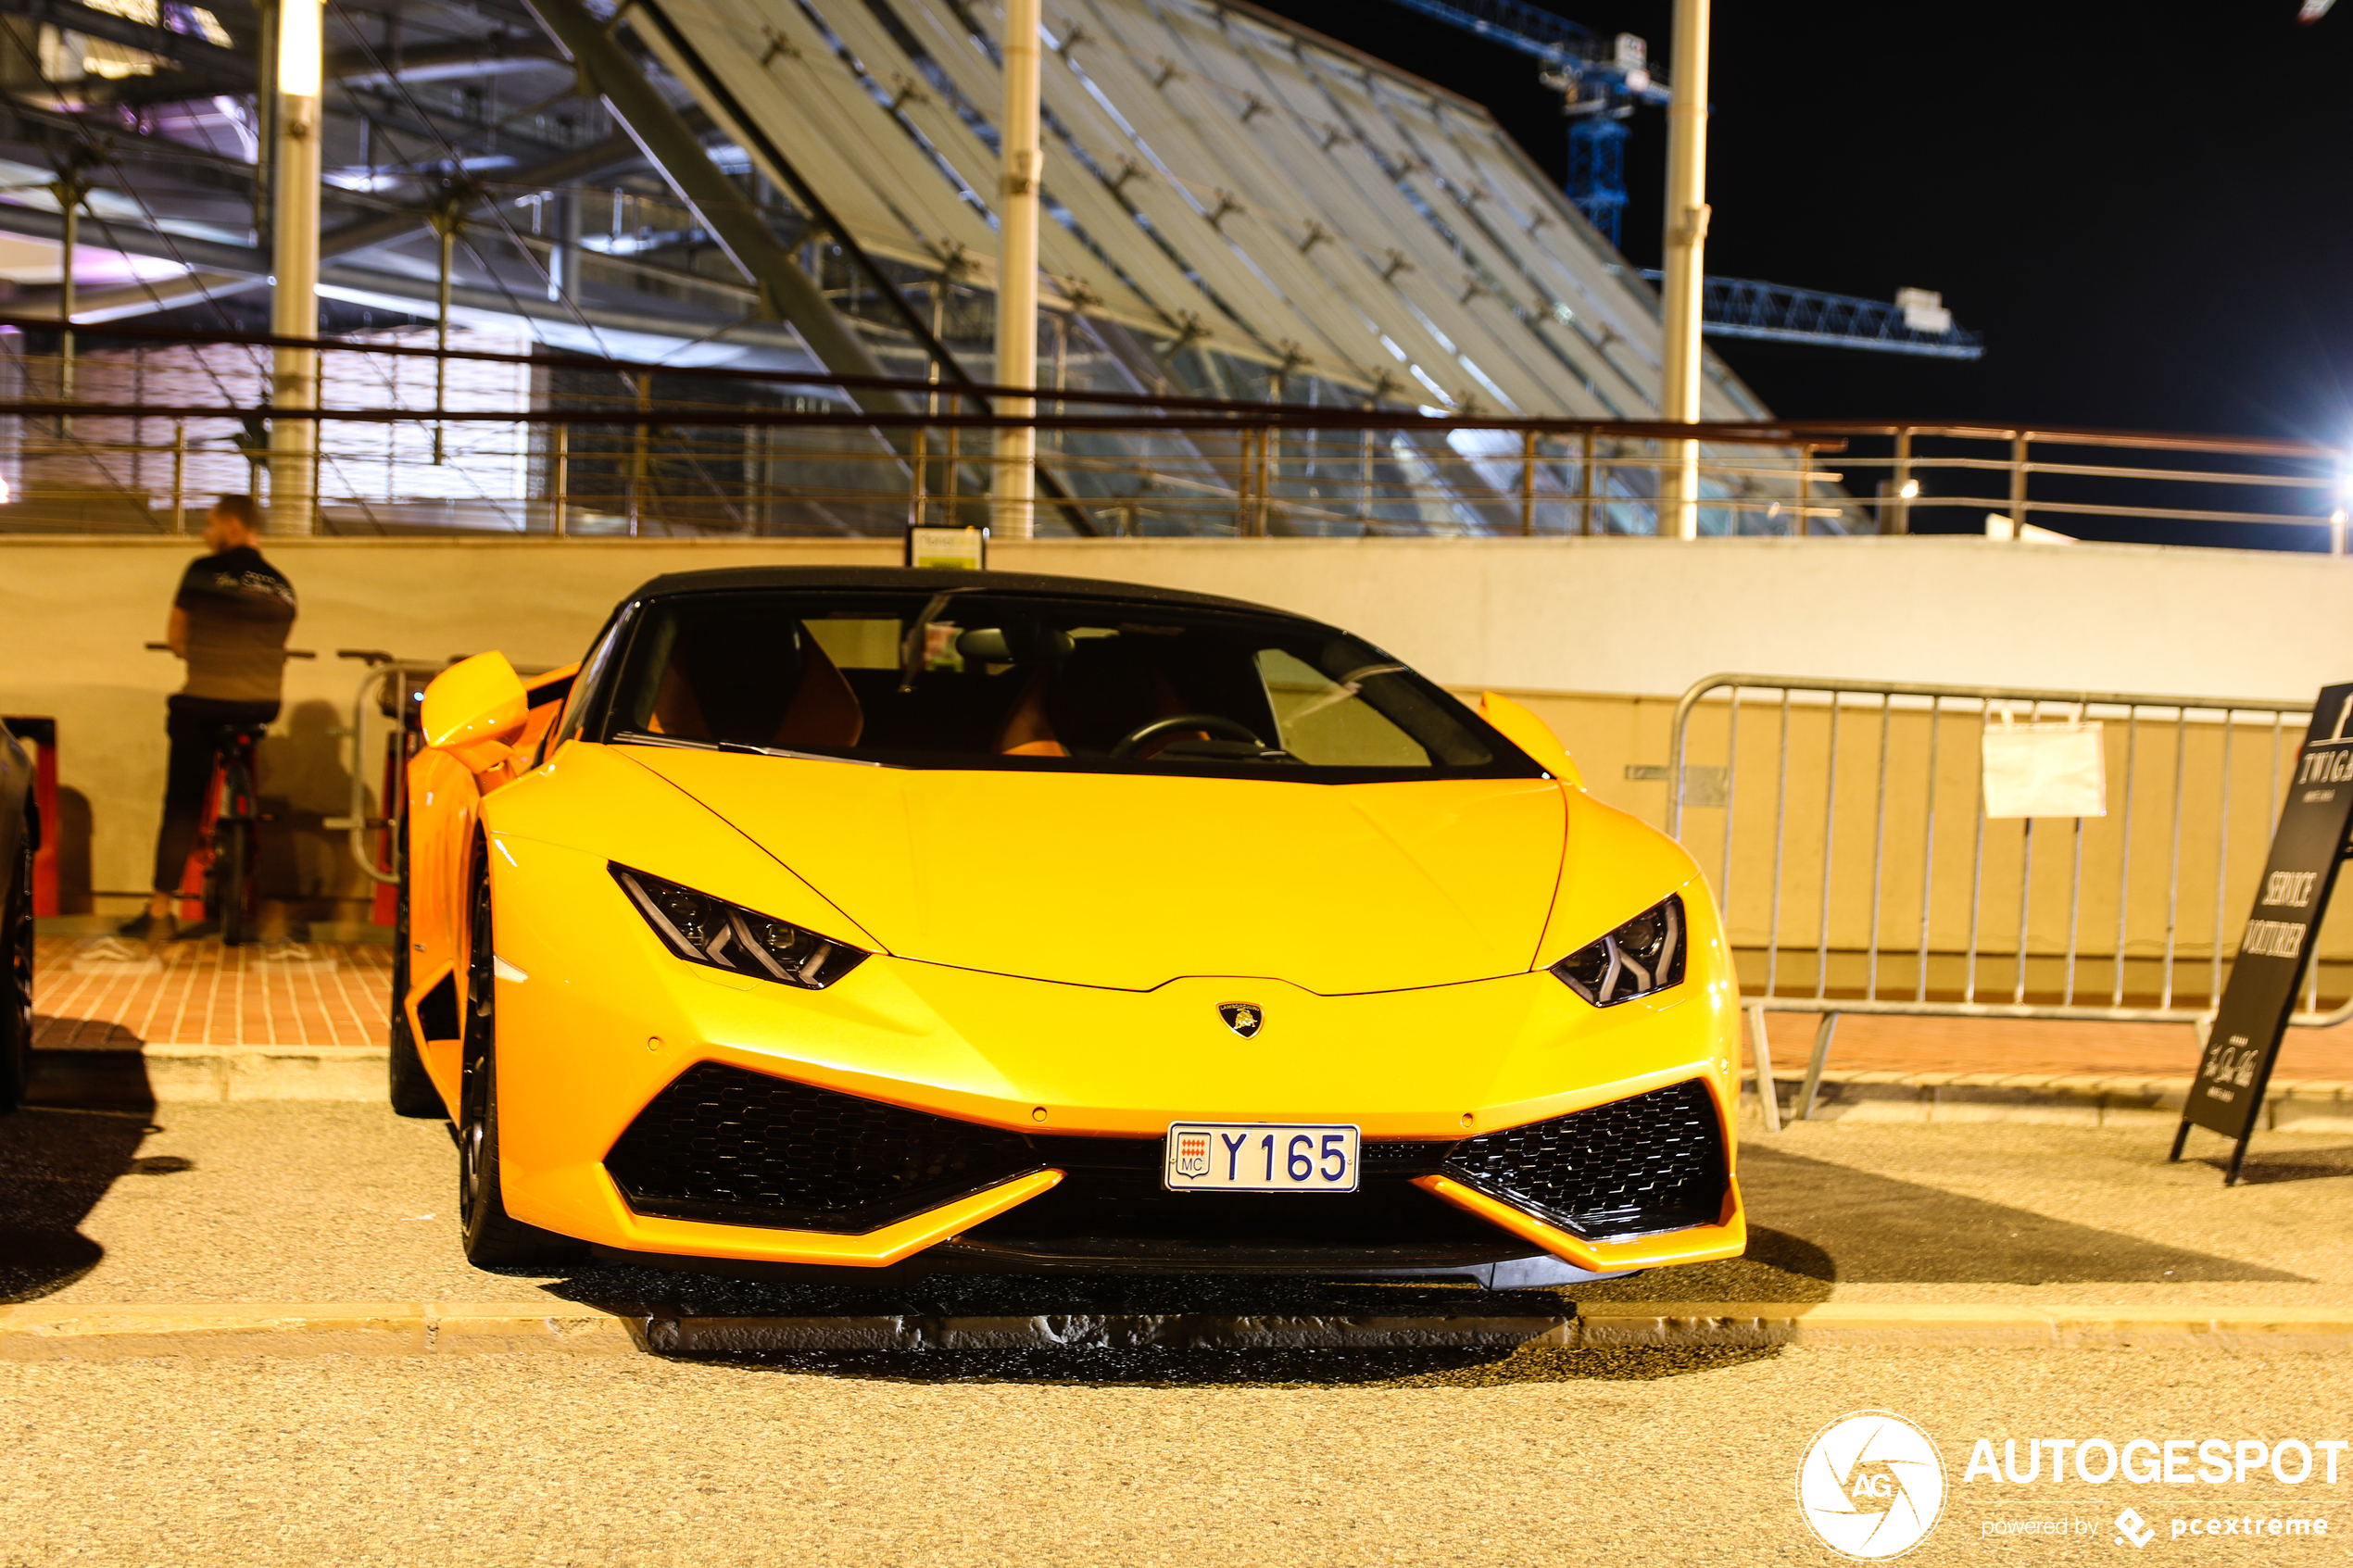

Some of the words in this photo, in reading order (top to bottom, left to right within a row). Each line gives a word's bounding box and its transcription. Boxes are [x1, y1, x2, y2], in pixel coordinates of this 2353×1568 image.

[2262, 871, 2317, 907] SERVICE
[1182, 1158, 1202, 1171] MC
[1221, 1134, 1346, 1182] Y165
